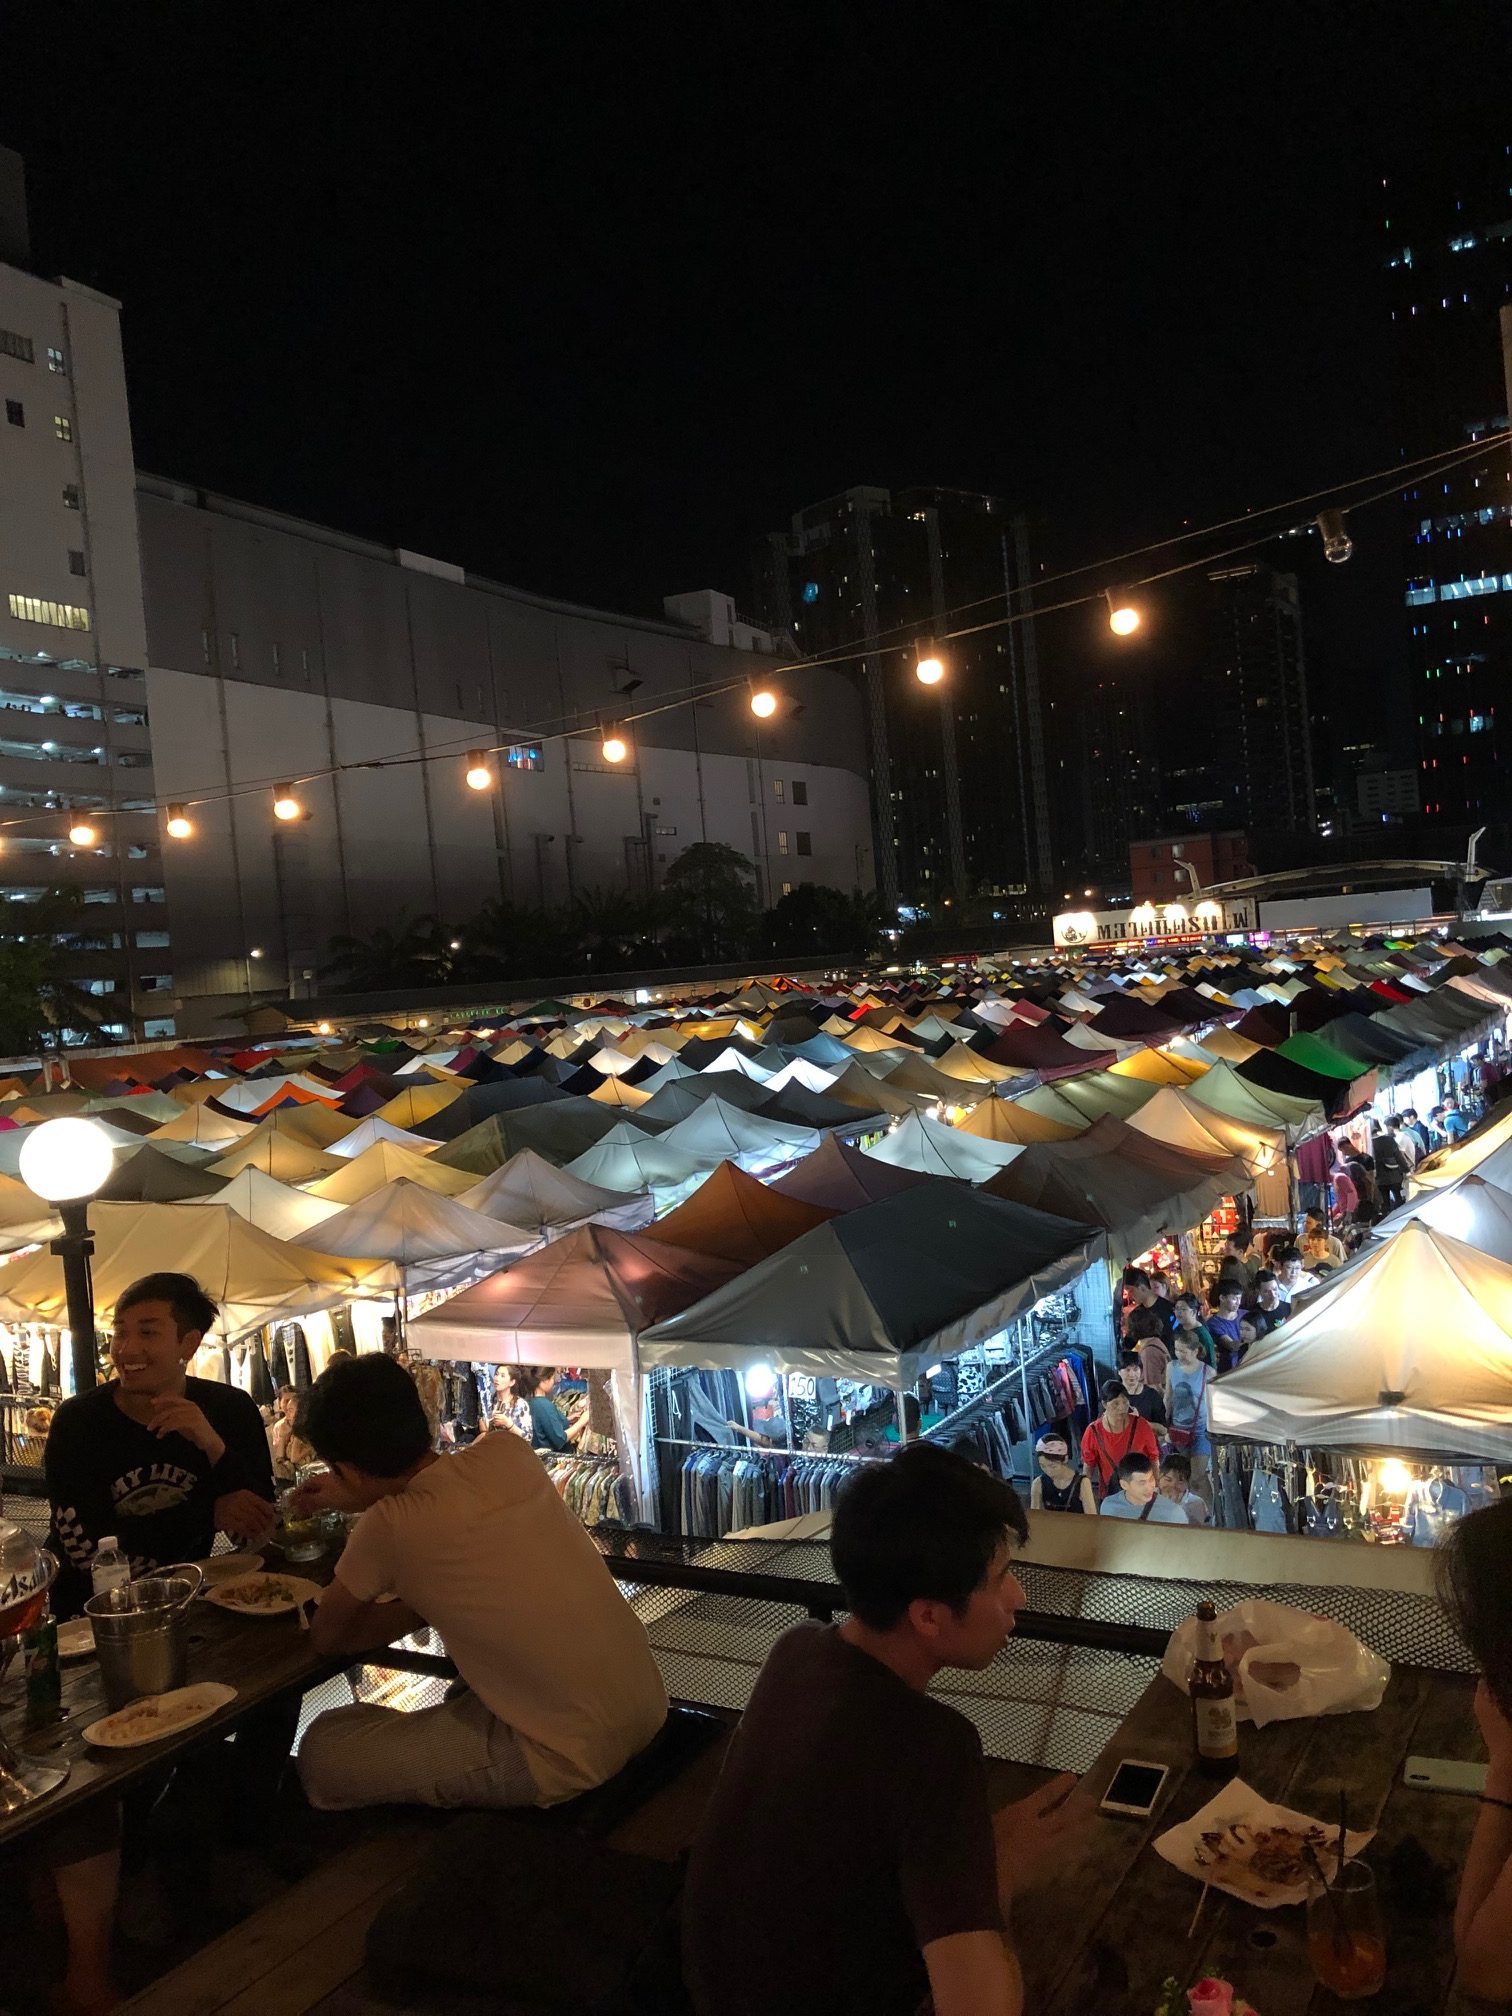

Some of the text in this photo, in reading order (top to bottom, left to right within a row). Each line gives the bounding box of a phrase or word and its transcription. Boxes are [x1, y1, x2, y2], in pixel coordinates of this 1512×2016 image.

[791, 1377, 815, 1396] 150
[110, 1463, 198, 1502] MY LIFE
